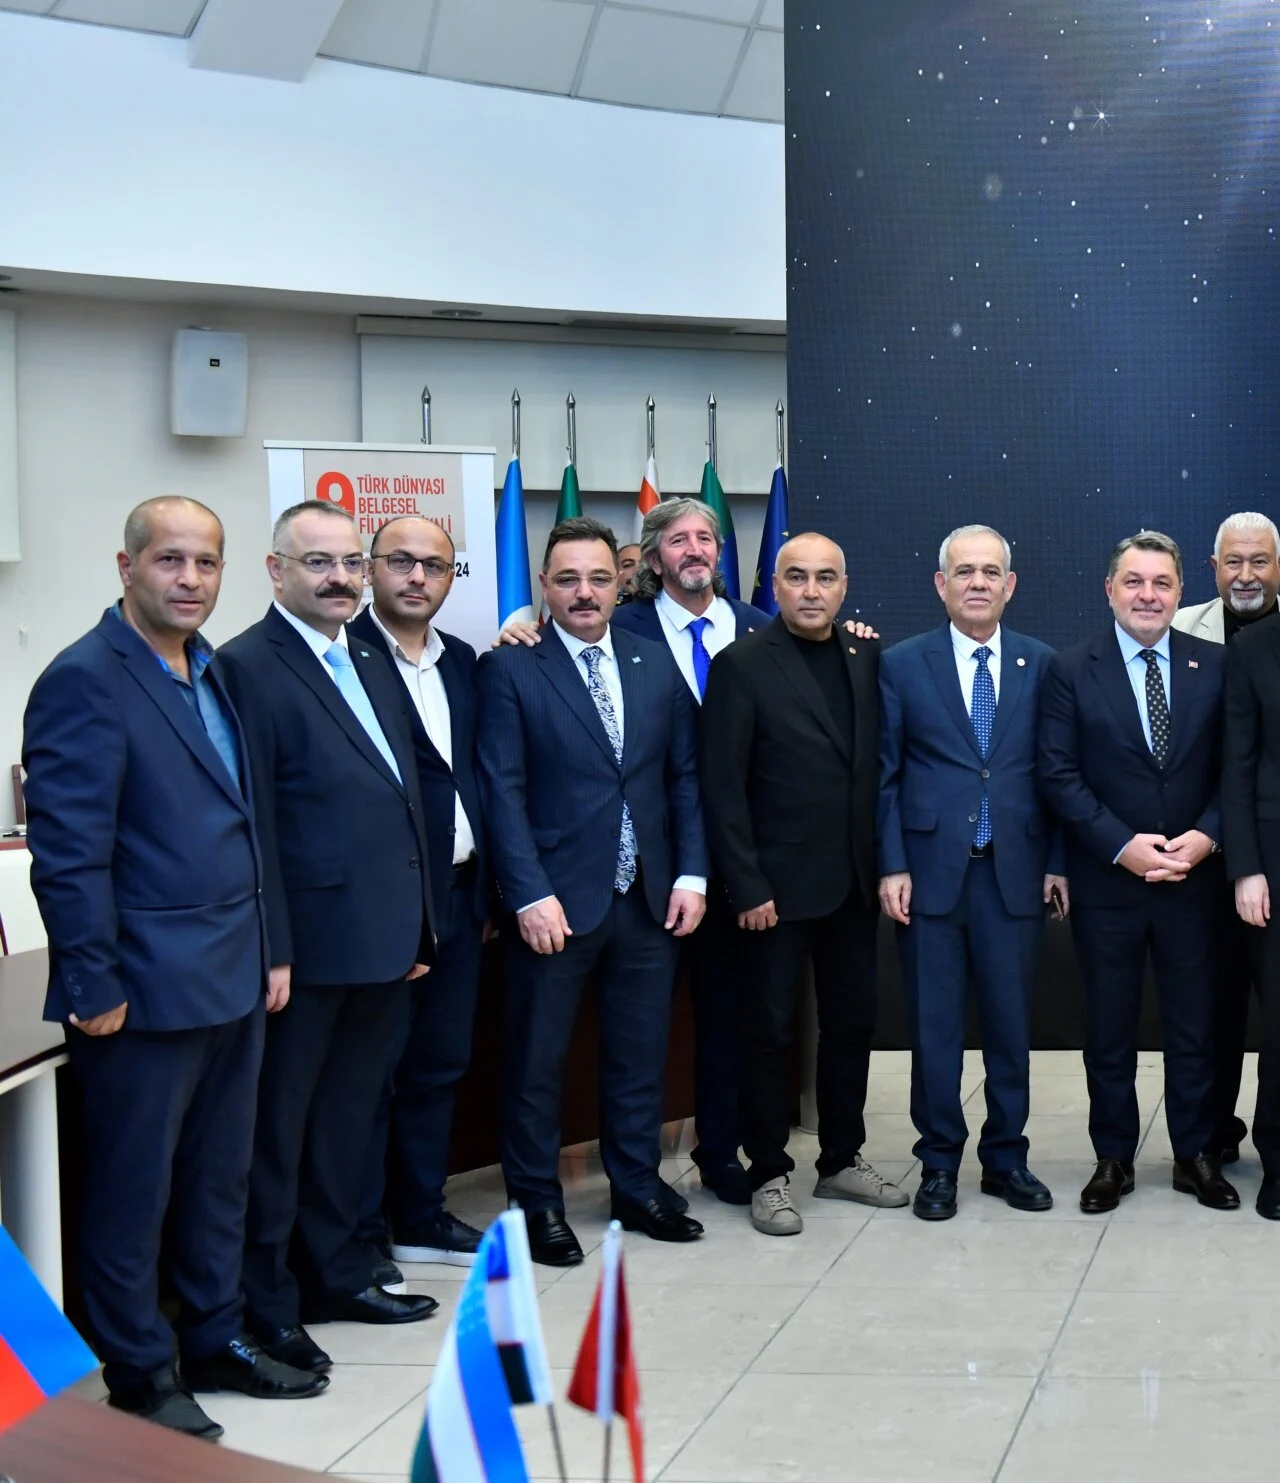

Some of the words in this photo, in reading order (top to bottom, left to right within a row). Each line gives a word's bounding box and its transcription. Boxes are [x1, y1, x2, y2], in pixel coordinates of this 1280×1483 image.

[357, 474, 390, 494] TÜRK
[394, 475, 445, 495] DÜNYASI
[358, 497, 420, 515] BELGESEL
